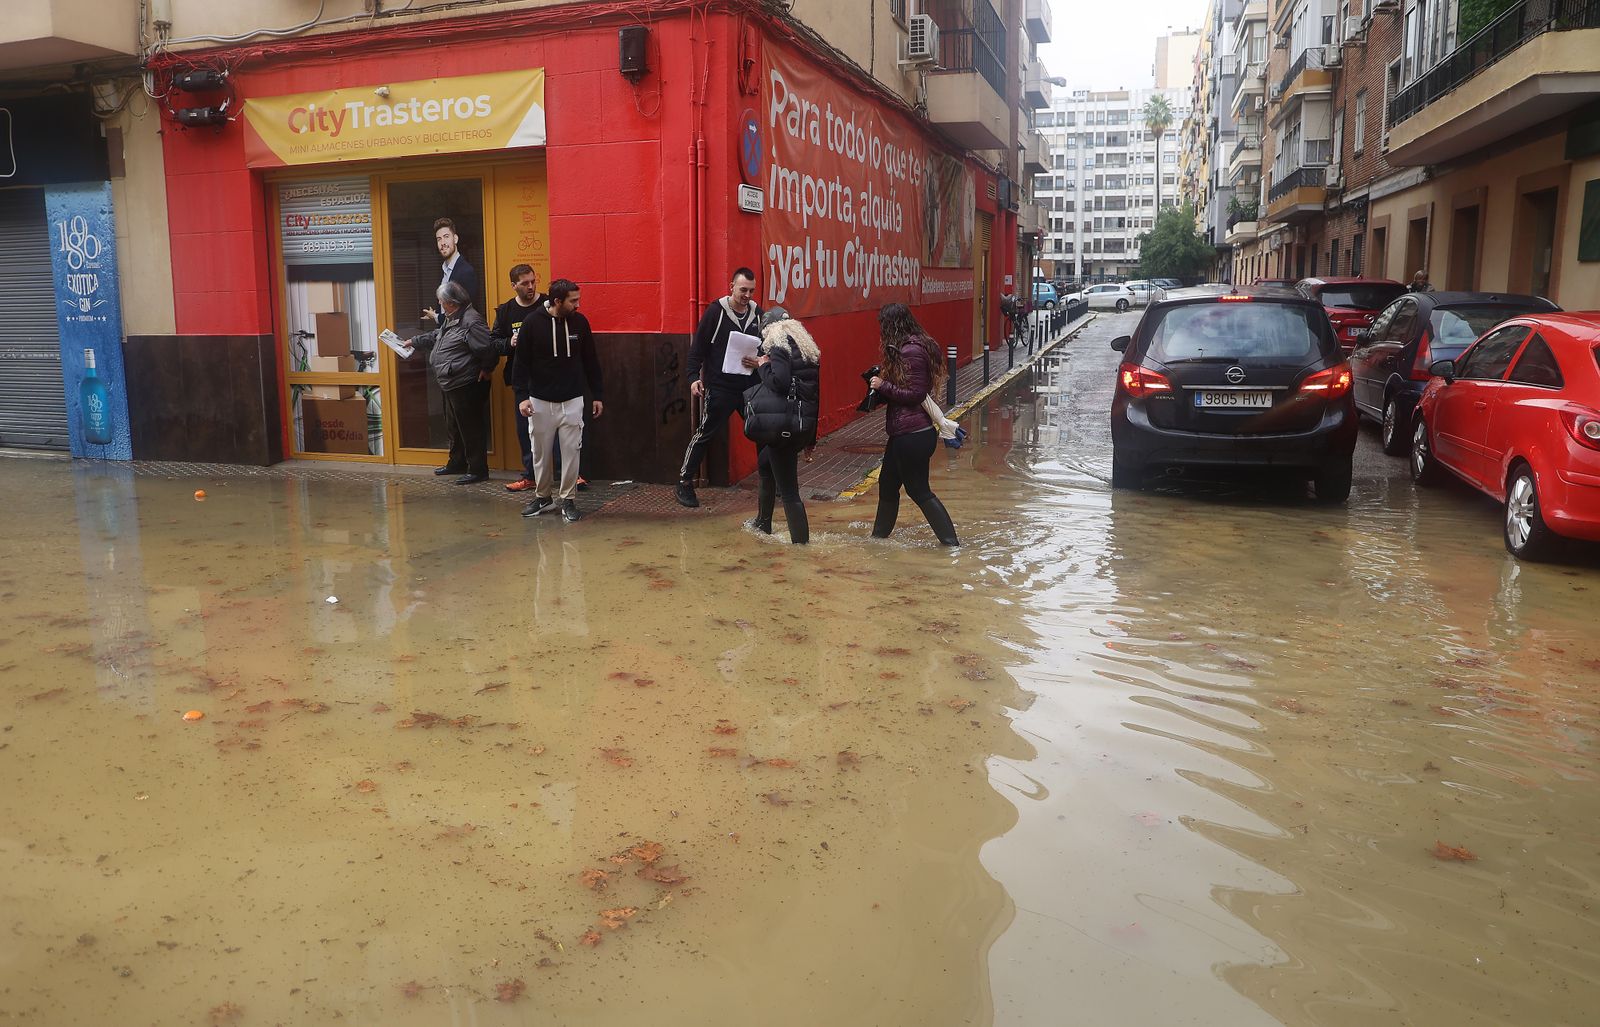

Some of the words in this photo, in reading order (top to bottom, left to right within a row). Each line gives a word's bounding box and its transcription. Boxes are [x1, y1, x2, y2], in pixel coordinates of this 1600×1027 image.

[287, 95, 492, 137] CityTrasteros
[770, 69, 821, 146] Para
[825, 102, 866, 164] todo
[868, 121, 881, 170] lo
[884, 142, 907, 185] que
[908, 148, 921, 186] te
[289, 144, 309, 155] MINI
[311, 139, 365, 153] ALMACENES
[366, 135, 413, 148] URBANOS
[414, 134, 421, 144] Y
[423, 128, 493, 144] BICICLETEROS
[320, 193, 367, 207] ESPACIO?
[769, 145, 857, 234] importa,
[860, 181, 903, 240] alquila
[303, 241, 320, 253] 689
[340, 240, 355, 251] 315
[768, 236, 811, 304] ¡ya!
[815, 239, 838, 289] tu
[843, 235, 920, 299] Citytrastero
[79, 298, 91, 313] GIN
[1205, 392, 1238, 405] 9805
[1243, 392, 1268, 405] HVV
